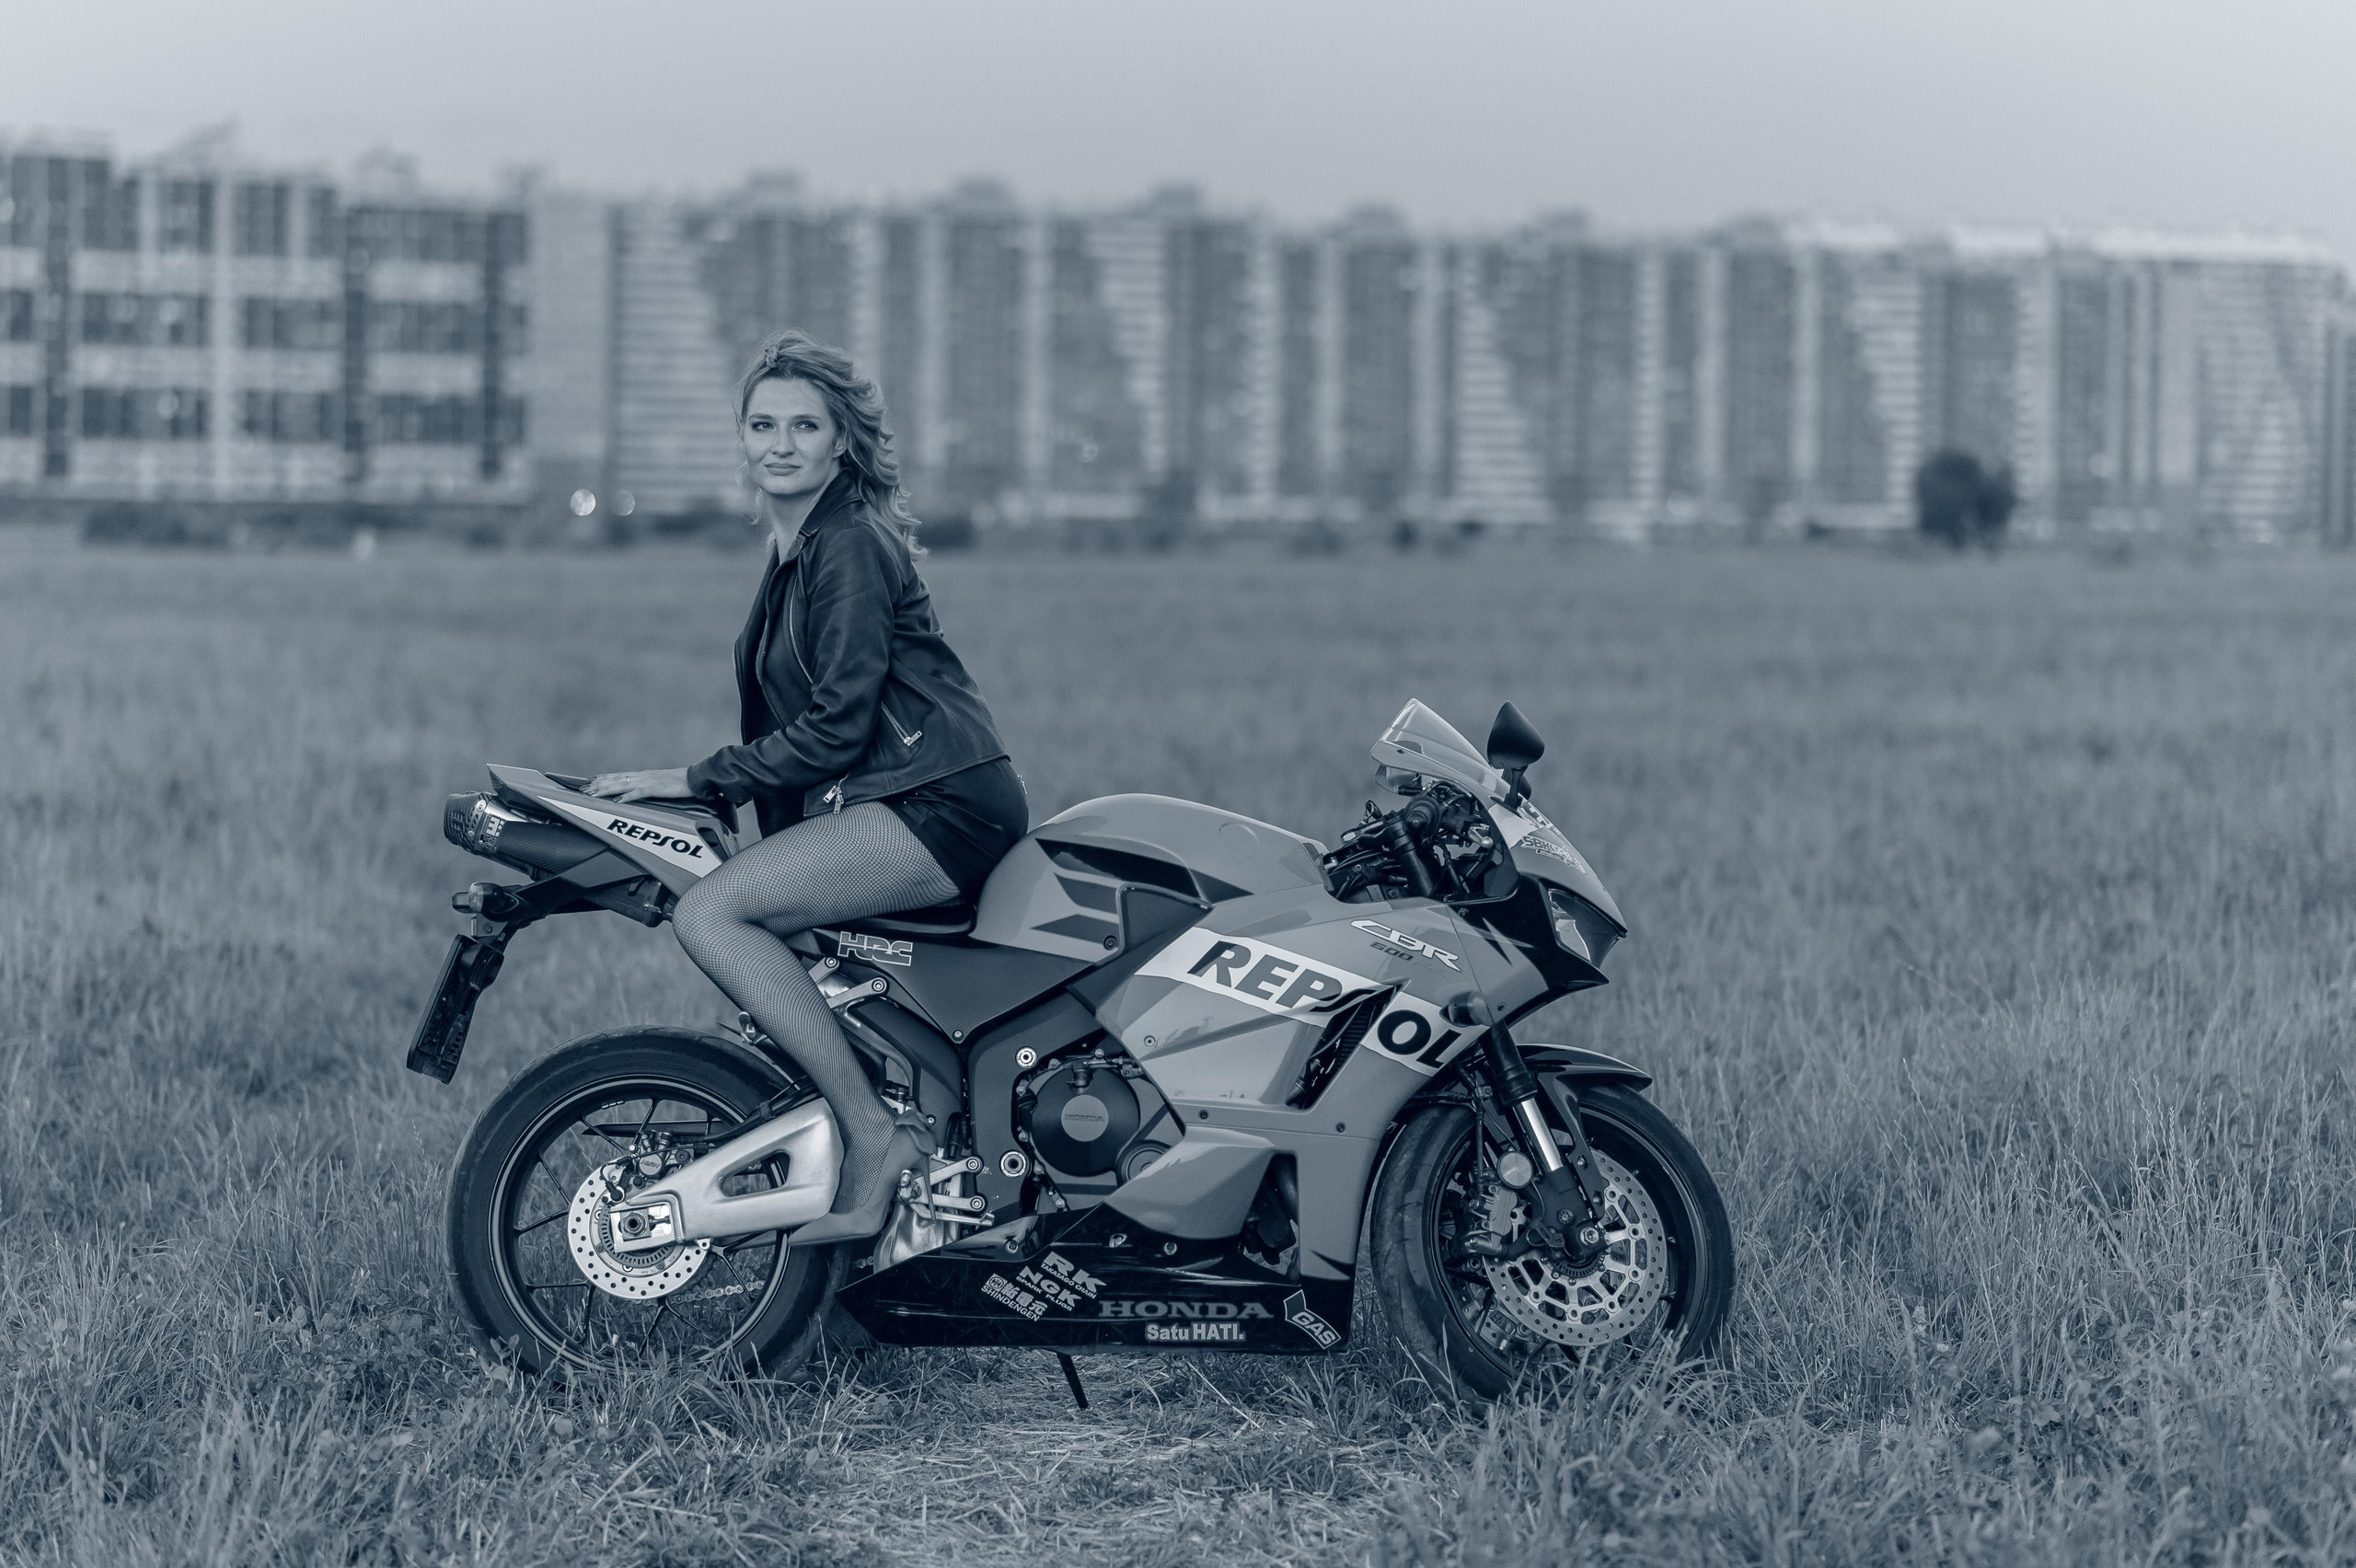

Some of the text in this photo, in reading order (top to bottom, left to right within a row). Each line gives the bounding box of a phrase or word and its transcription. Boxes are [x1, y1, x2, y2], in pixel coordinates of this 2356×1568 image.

[607, 819, 704, 859] REPSOL
[837, 930, 913, 966] HRC
[1350, 919, 1461, 972] CBR
[1019, 1265, 1082, 1307] NGK
[1040, 1262, 1097, 1299] TAKASAGO CHAIN
[1043, 1251, 1107, 1293] RK
[981, 1285, 1040, 1321] SHINDENGEN
[1015, 1276, 1073, 1311] SPARK PLUGS
[1099, 1300, 1274, 1319] HONDA
[1147, 1324, 1189, 1340] Satu
[1291, 1311, 1335, 1345] GAS
